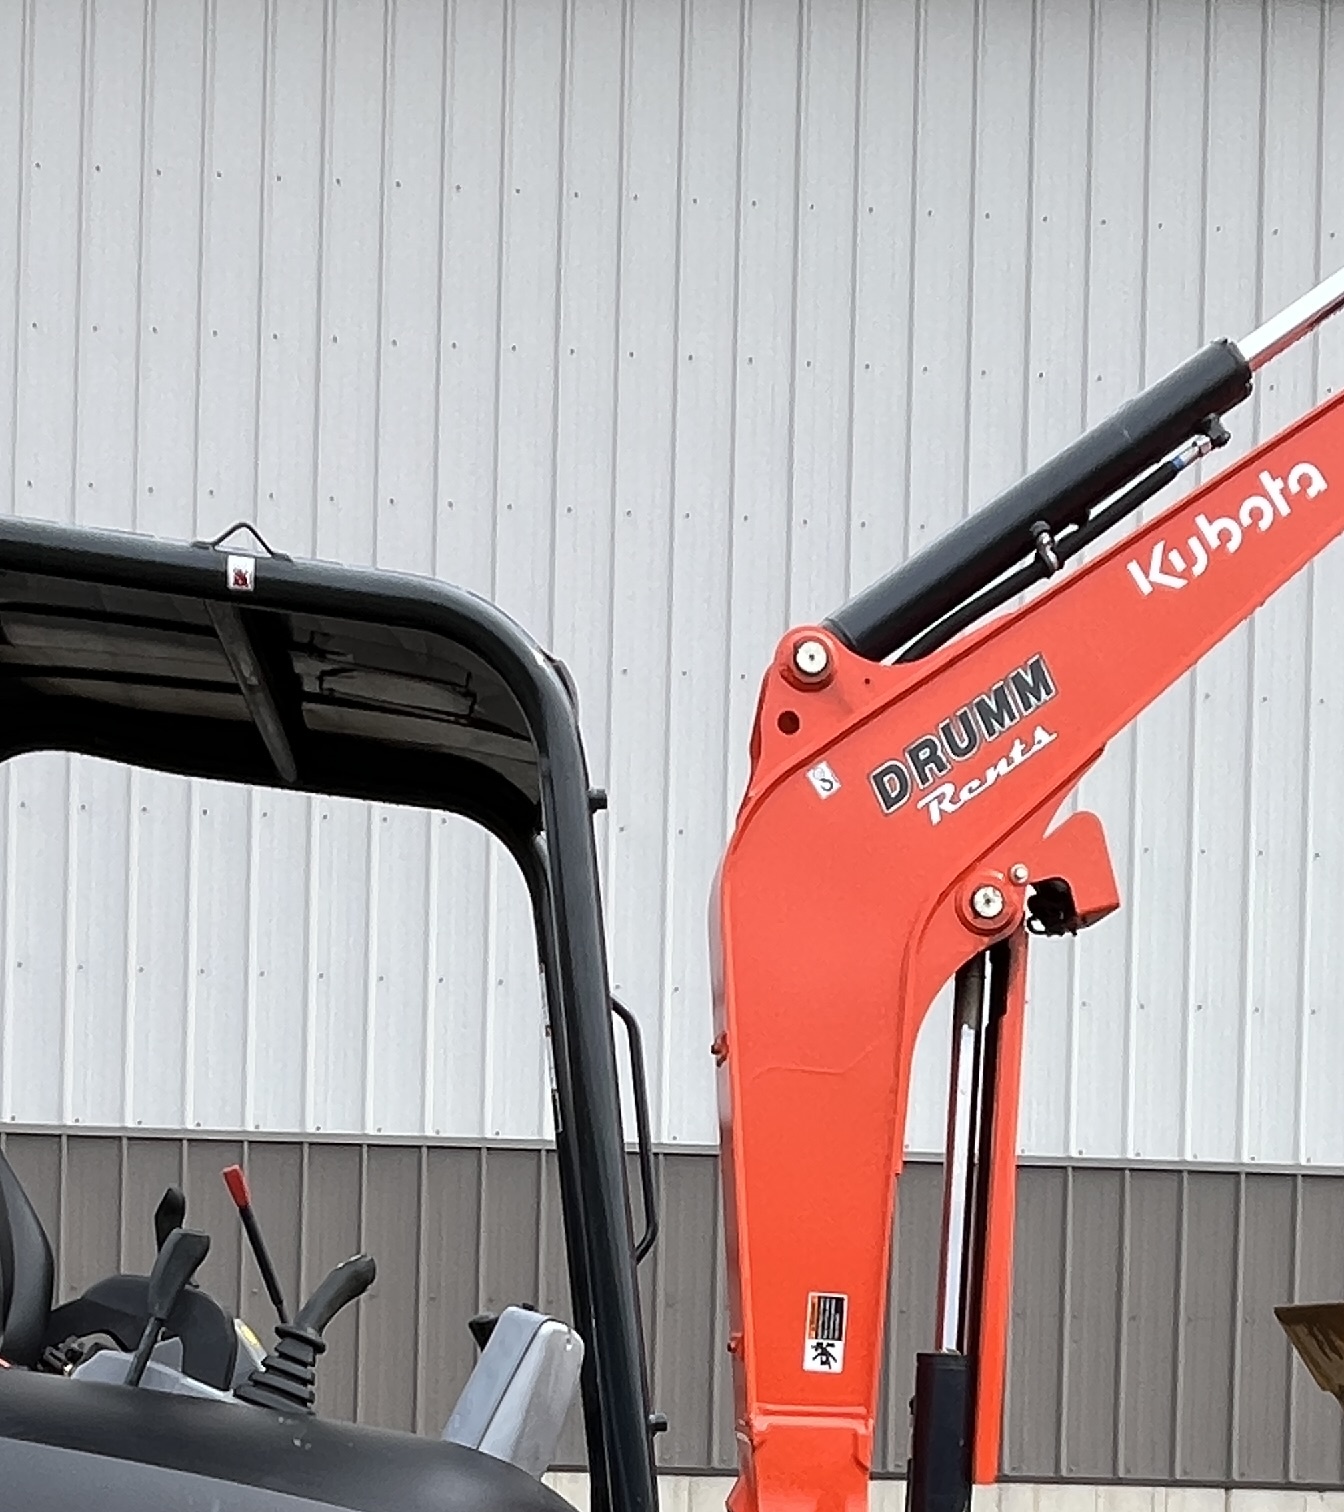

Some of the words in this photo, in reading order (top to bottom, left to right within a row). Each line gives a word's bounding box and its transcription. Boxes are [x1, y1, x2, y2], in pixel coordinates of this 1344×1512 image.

[1126, 462, 1328, 596] Kubota
[868, 652, 1058, 815] DRUMM
[916, 724, 1058, 825] Rents
